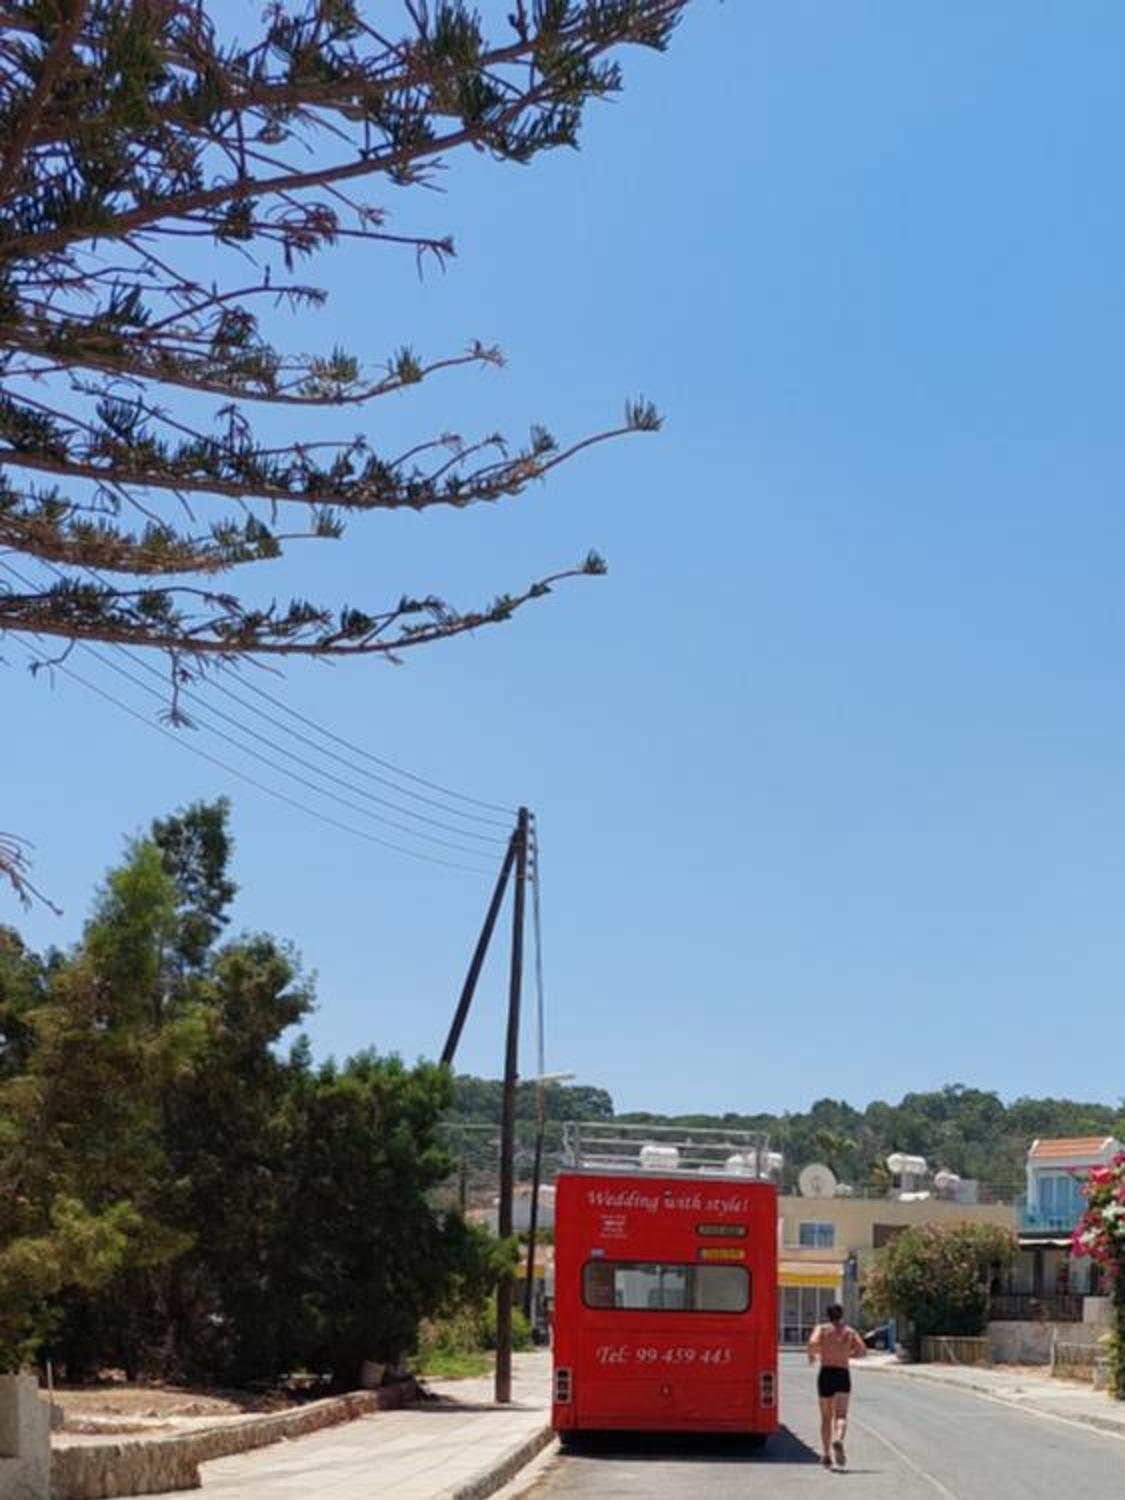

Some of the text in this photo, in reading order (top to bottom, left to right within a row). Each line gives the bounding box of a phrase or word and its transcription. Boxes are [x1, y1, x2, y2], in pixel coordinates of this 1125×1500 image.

[588, 1190, 748, 1216] Wedding with style!
[636, 1346, 659, 1363] 99
[662, 1346, 696, 1364] 459
